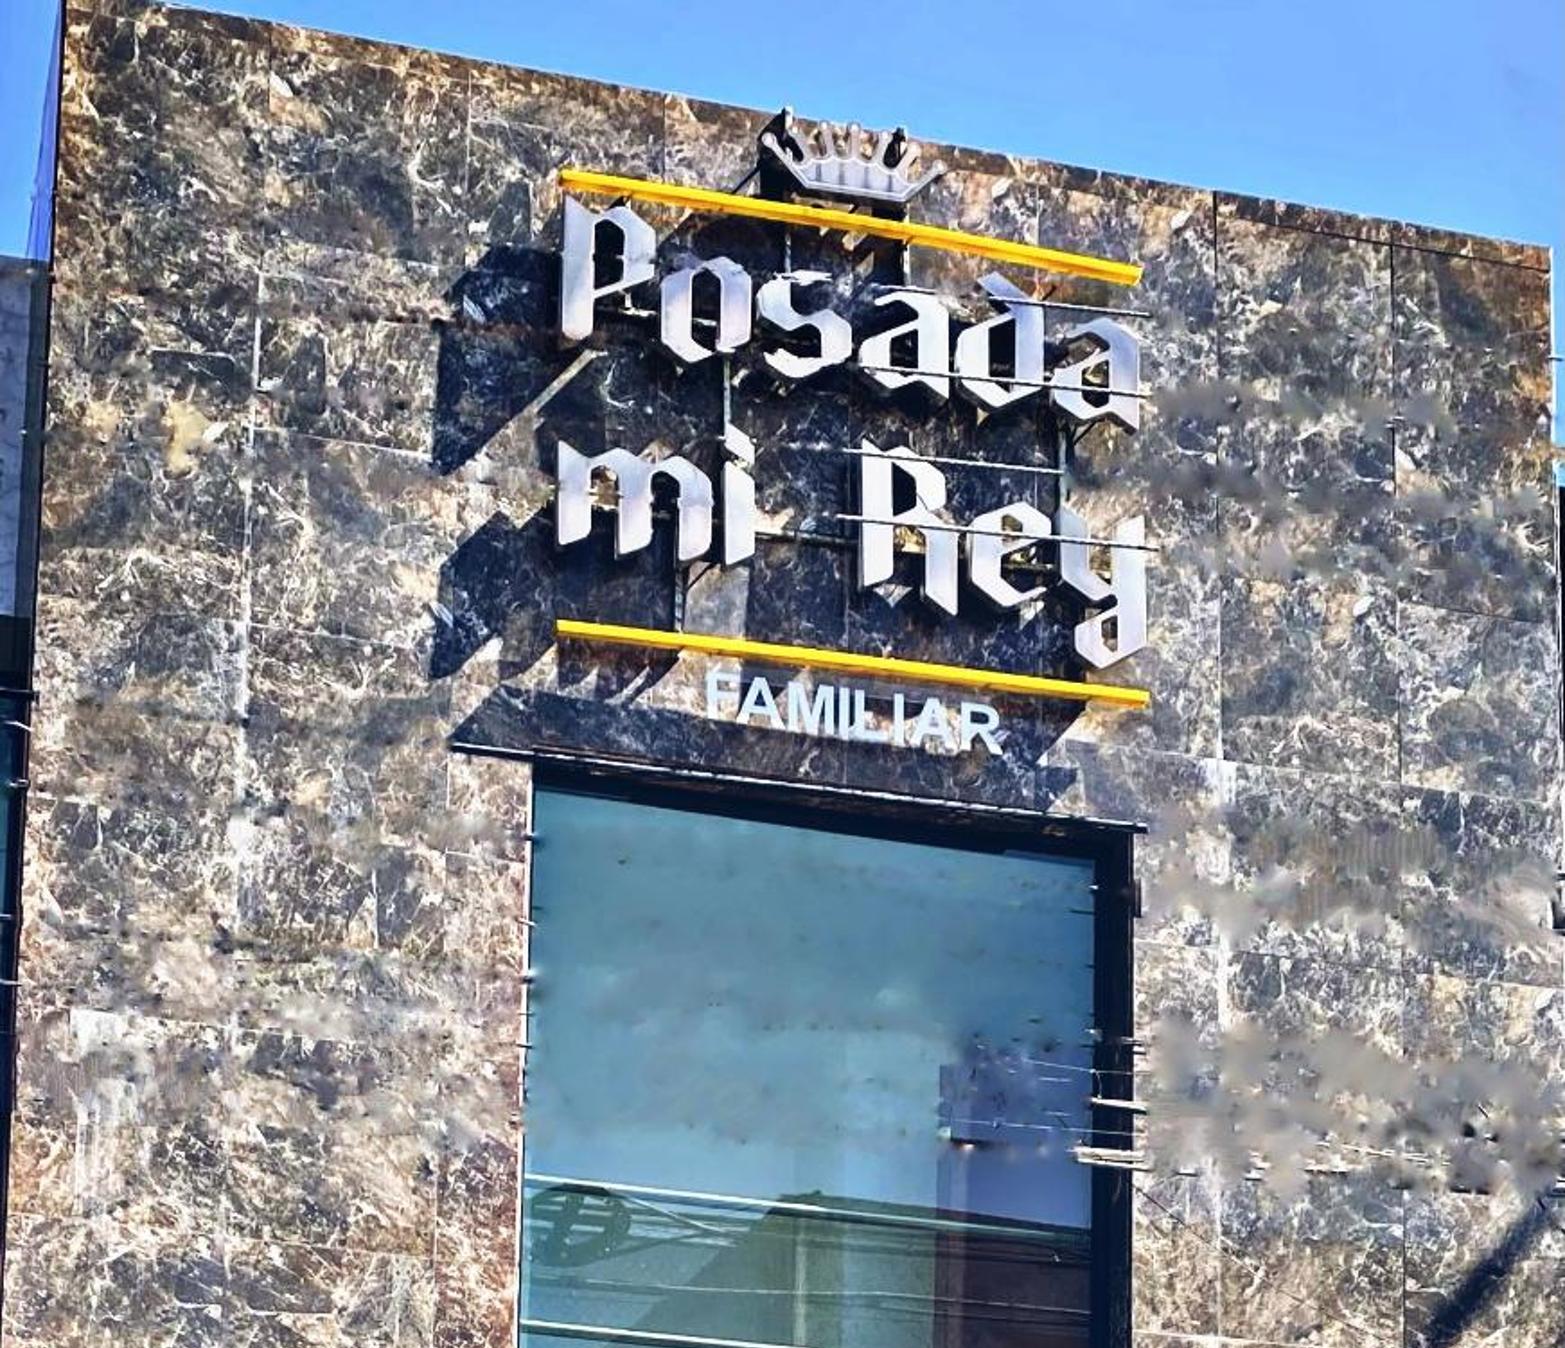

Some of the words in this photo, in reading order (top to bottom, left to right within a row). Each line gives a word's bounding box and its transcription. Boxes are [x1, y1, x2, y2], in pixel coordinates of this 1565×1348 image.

[560, 197, 1142, 434] Posada
[556, 422, 757, 566] mi
[858, 438, 1149, 670] Rey
[706, 671, 1003, 755] FAMILIAR
